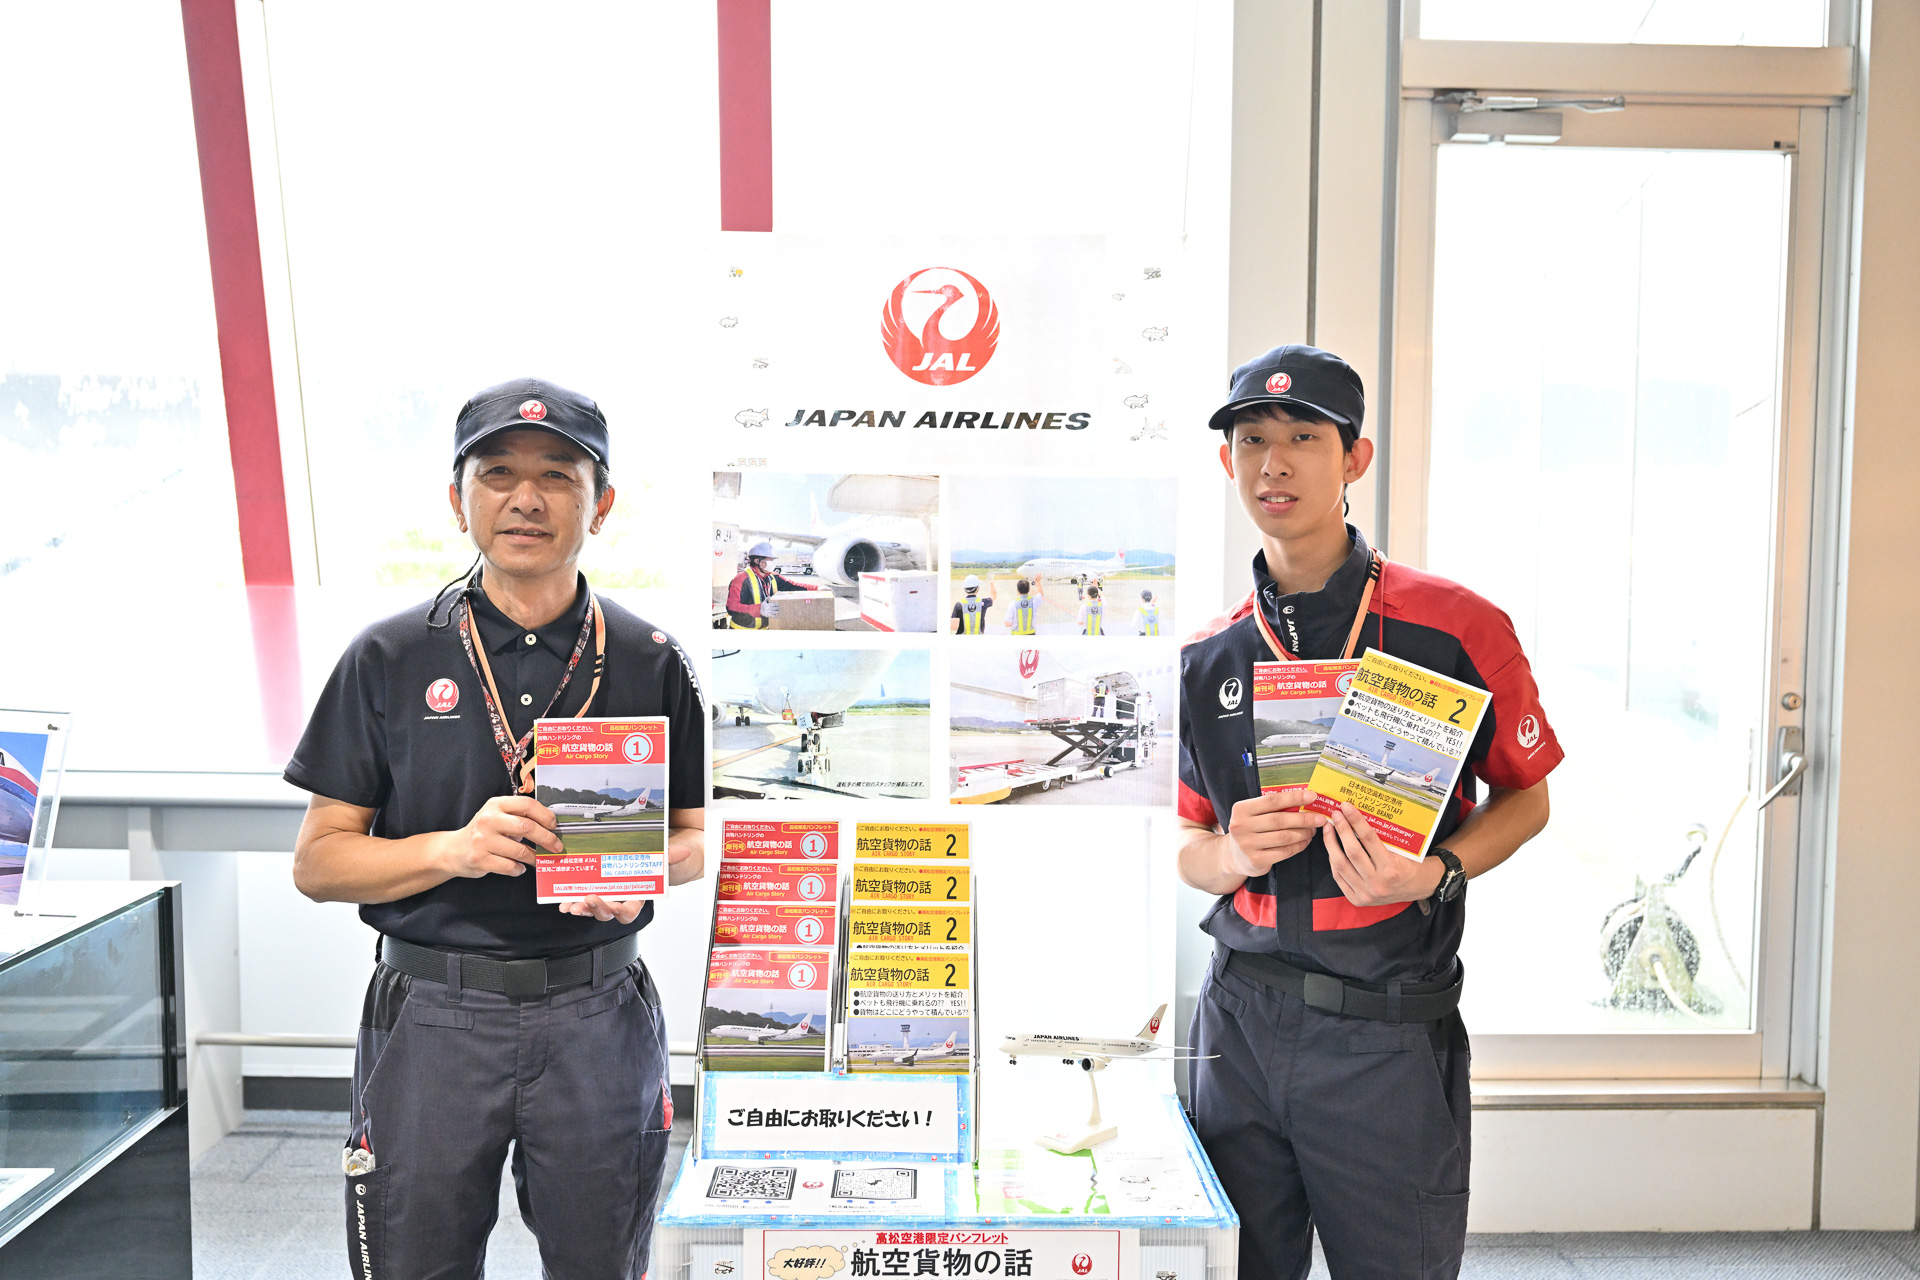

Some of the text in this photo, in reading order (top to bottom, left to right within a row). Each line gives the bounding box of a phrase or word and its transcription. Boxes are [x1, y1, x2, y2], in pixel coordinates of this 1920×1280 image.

[911, 352, 977, 371] JAL
[785, 409, 1092, 430] JAPAN AIRLINES
[1286, 618, 1300, 652] JAPAN
[1276, 680, 1327, 690] 航空貨物の話
[1354, 667, 1438, 709] 航空貨物の話
[1368, 686, 1416, 708] AIR CARGO STORY
[1357, 692, 1464, 739] 航空貨物の送り方とメリットを紹介
[1448, 698, 1468, 724] 2
[1446, 736, 1464, 748] YES!!
[1526, 734, 1538, 746] JAL
[538, 746, 560, 755] 創刊号
[562, 743, 614, 752] 航空貨物の話
[632, 741, 642, 756] 1
[1340, 786, 1404, 816] 貨物ハンドリングSTAFF
[1358, 801, 1375, 812] CARGO
[1376, 808, 1394, 820] BRAND
[746, 840, 792, 848] 航空貨物の話
[809, 839, 818, 852] 1
[856, 838, 932, 852] 航空貨物の話
[946, 834, 956, 856] 2
[743, 882, 790, 890] 航空貨物の話
[807, 881, 815, 894] 1
[856, 879, 932, 894] 航空貨物の話
[946, 876, 958, 900] 2
[740, 924, 787, 934] 航空貨物の話
[804, 924, 813, 938] 1
[852, 921, 932, 936] 航空貨物の話
[946, 917, 958, 940] 2
[732, 970, 780, 978] 航空貨物の話
[797, 969, 806, 983] 1
[850, 968, 930, 982] 航空貨物の話
[945, 964, 956, 986] 2
[860, 990, 964, 998] 航空貨物の送り方とメリットを紹介
[860, 1008, 968, 1016] 貨物はどこにどうやって積んでいる??
[727, 1108, 933, 1128] ご自由にお取りください！
[356, 1200, 367, 1240] JAPAN
[876, 1232, 1008, 1244] 高松空港限定パンフレット
[782, 1258, 826, 1269] 大好評!!
[851, 1248, 1032, 1276] 航空貨物の話
